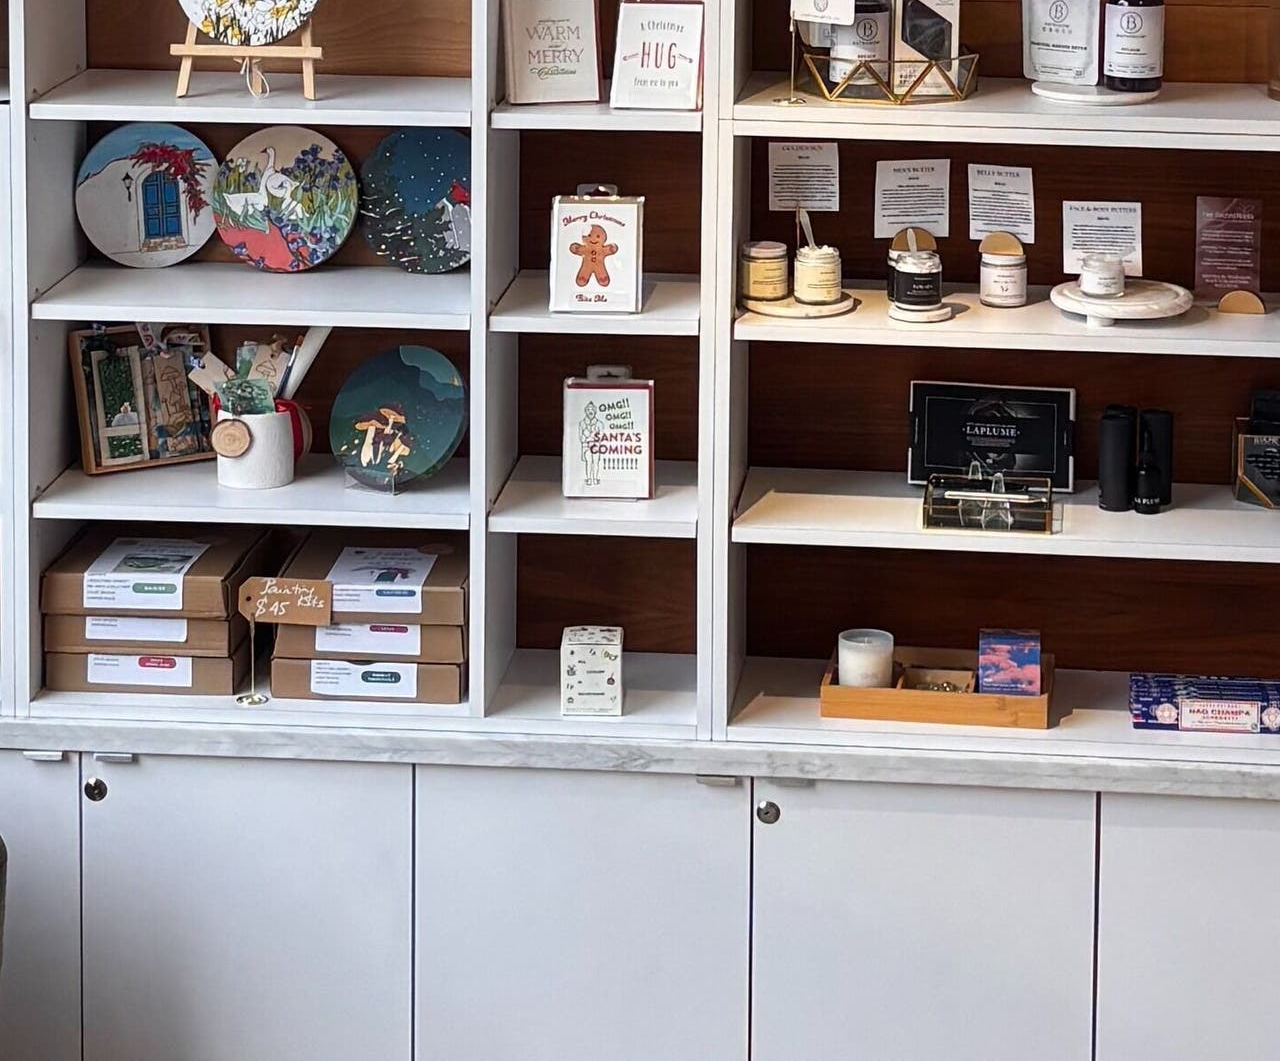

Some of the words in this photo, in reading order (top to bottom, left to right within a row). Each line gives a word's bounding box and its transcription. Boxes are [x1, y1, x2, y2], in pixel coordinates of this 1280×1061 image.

[526, 26, 581, 41] WARM
[528, 48, 584, 65] MERRY
[641, 41, 677, 69] HUG
[598, 398, 630, 413] OMG!!
[605, 411, 632, 421] OMG!!
[609, 421, 634, 430] OMG!!
[594, 432, 642, 442] SANTA'S
[589, 445, 642, 455] COMING
[260, 579, 315, 595] Painting
[297, 596, 324, 609] Kits
[255, 597, 290, 617] $45
[1189, 708, 1209, 716] NAG
